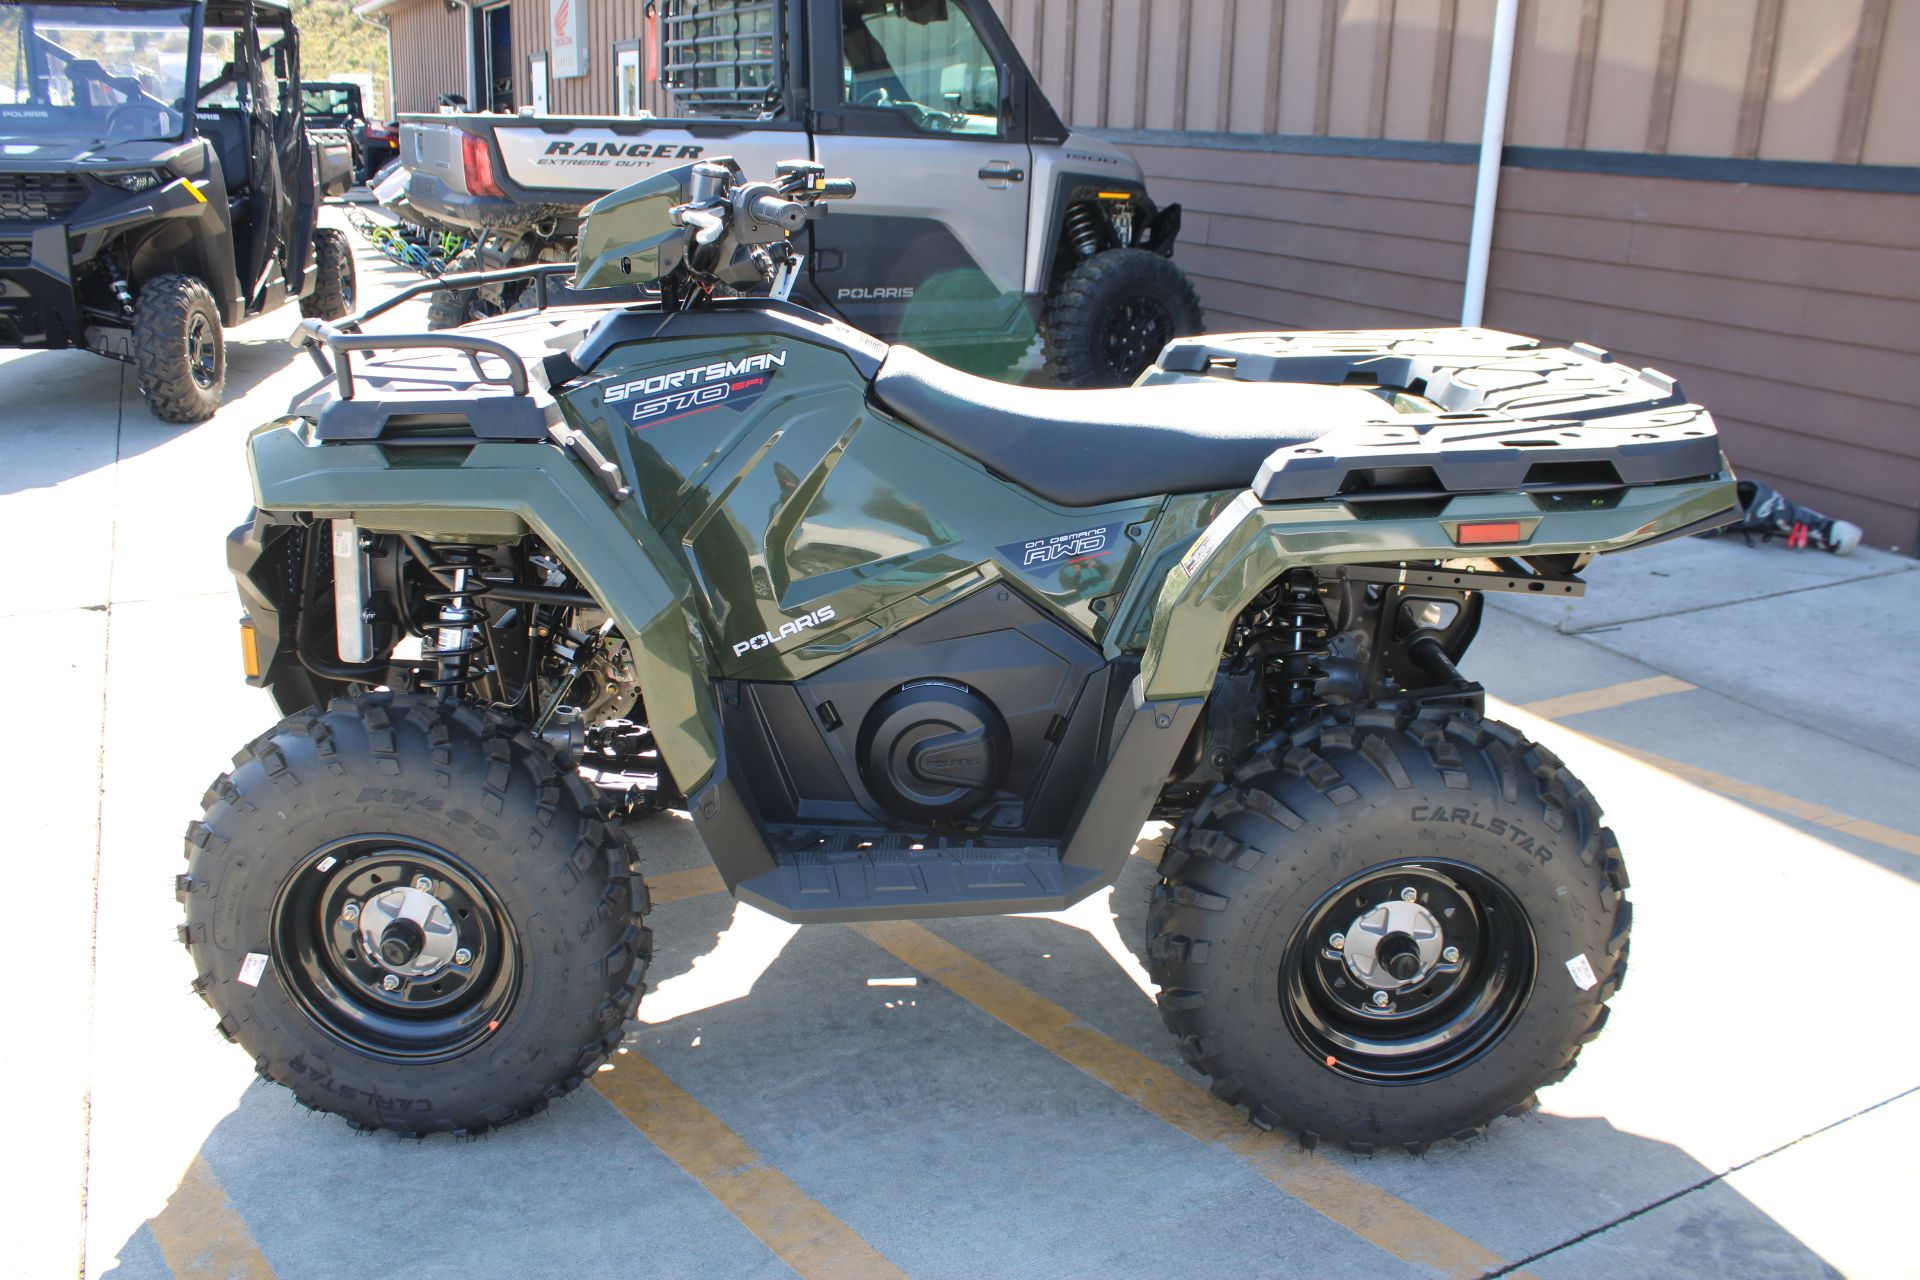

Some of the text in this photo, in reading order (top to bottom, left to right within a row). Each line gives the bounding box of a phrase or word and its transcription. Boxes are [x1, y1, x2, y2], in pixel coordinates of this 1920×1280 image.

[3, 110, 48, 118] POLARIS
[537, 158, 611, 167] EXTREME
[544, 141, 704, 159] RANGER
[837, 287, 914, 299] POLARIS
[603, 350, 787, 404] SPORTSMAN
[632, 378, 764, 421] 570 EFI
[1023, 534, 1106, 566] AWD
[1050, 527, 1107, 544] DEMAND
[732, 604, 836, 658] POLARIS
[1411, 805, 1553, 867] CARLSTAR
[288, 1054, 433, 1113] CARLSTAR
